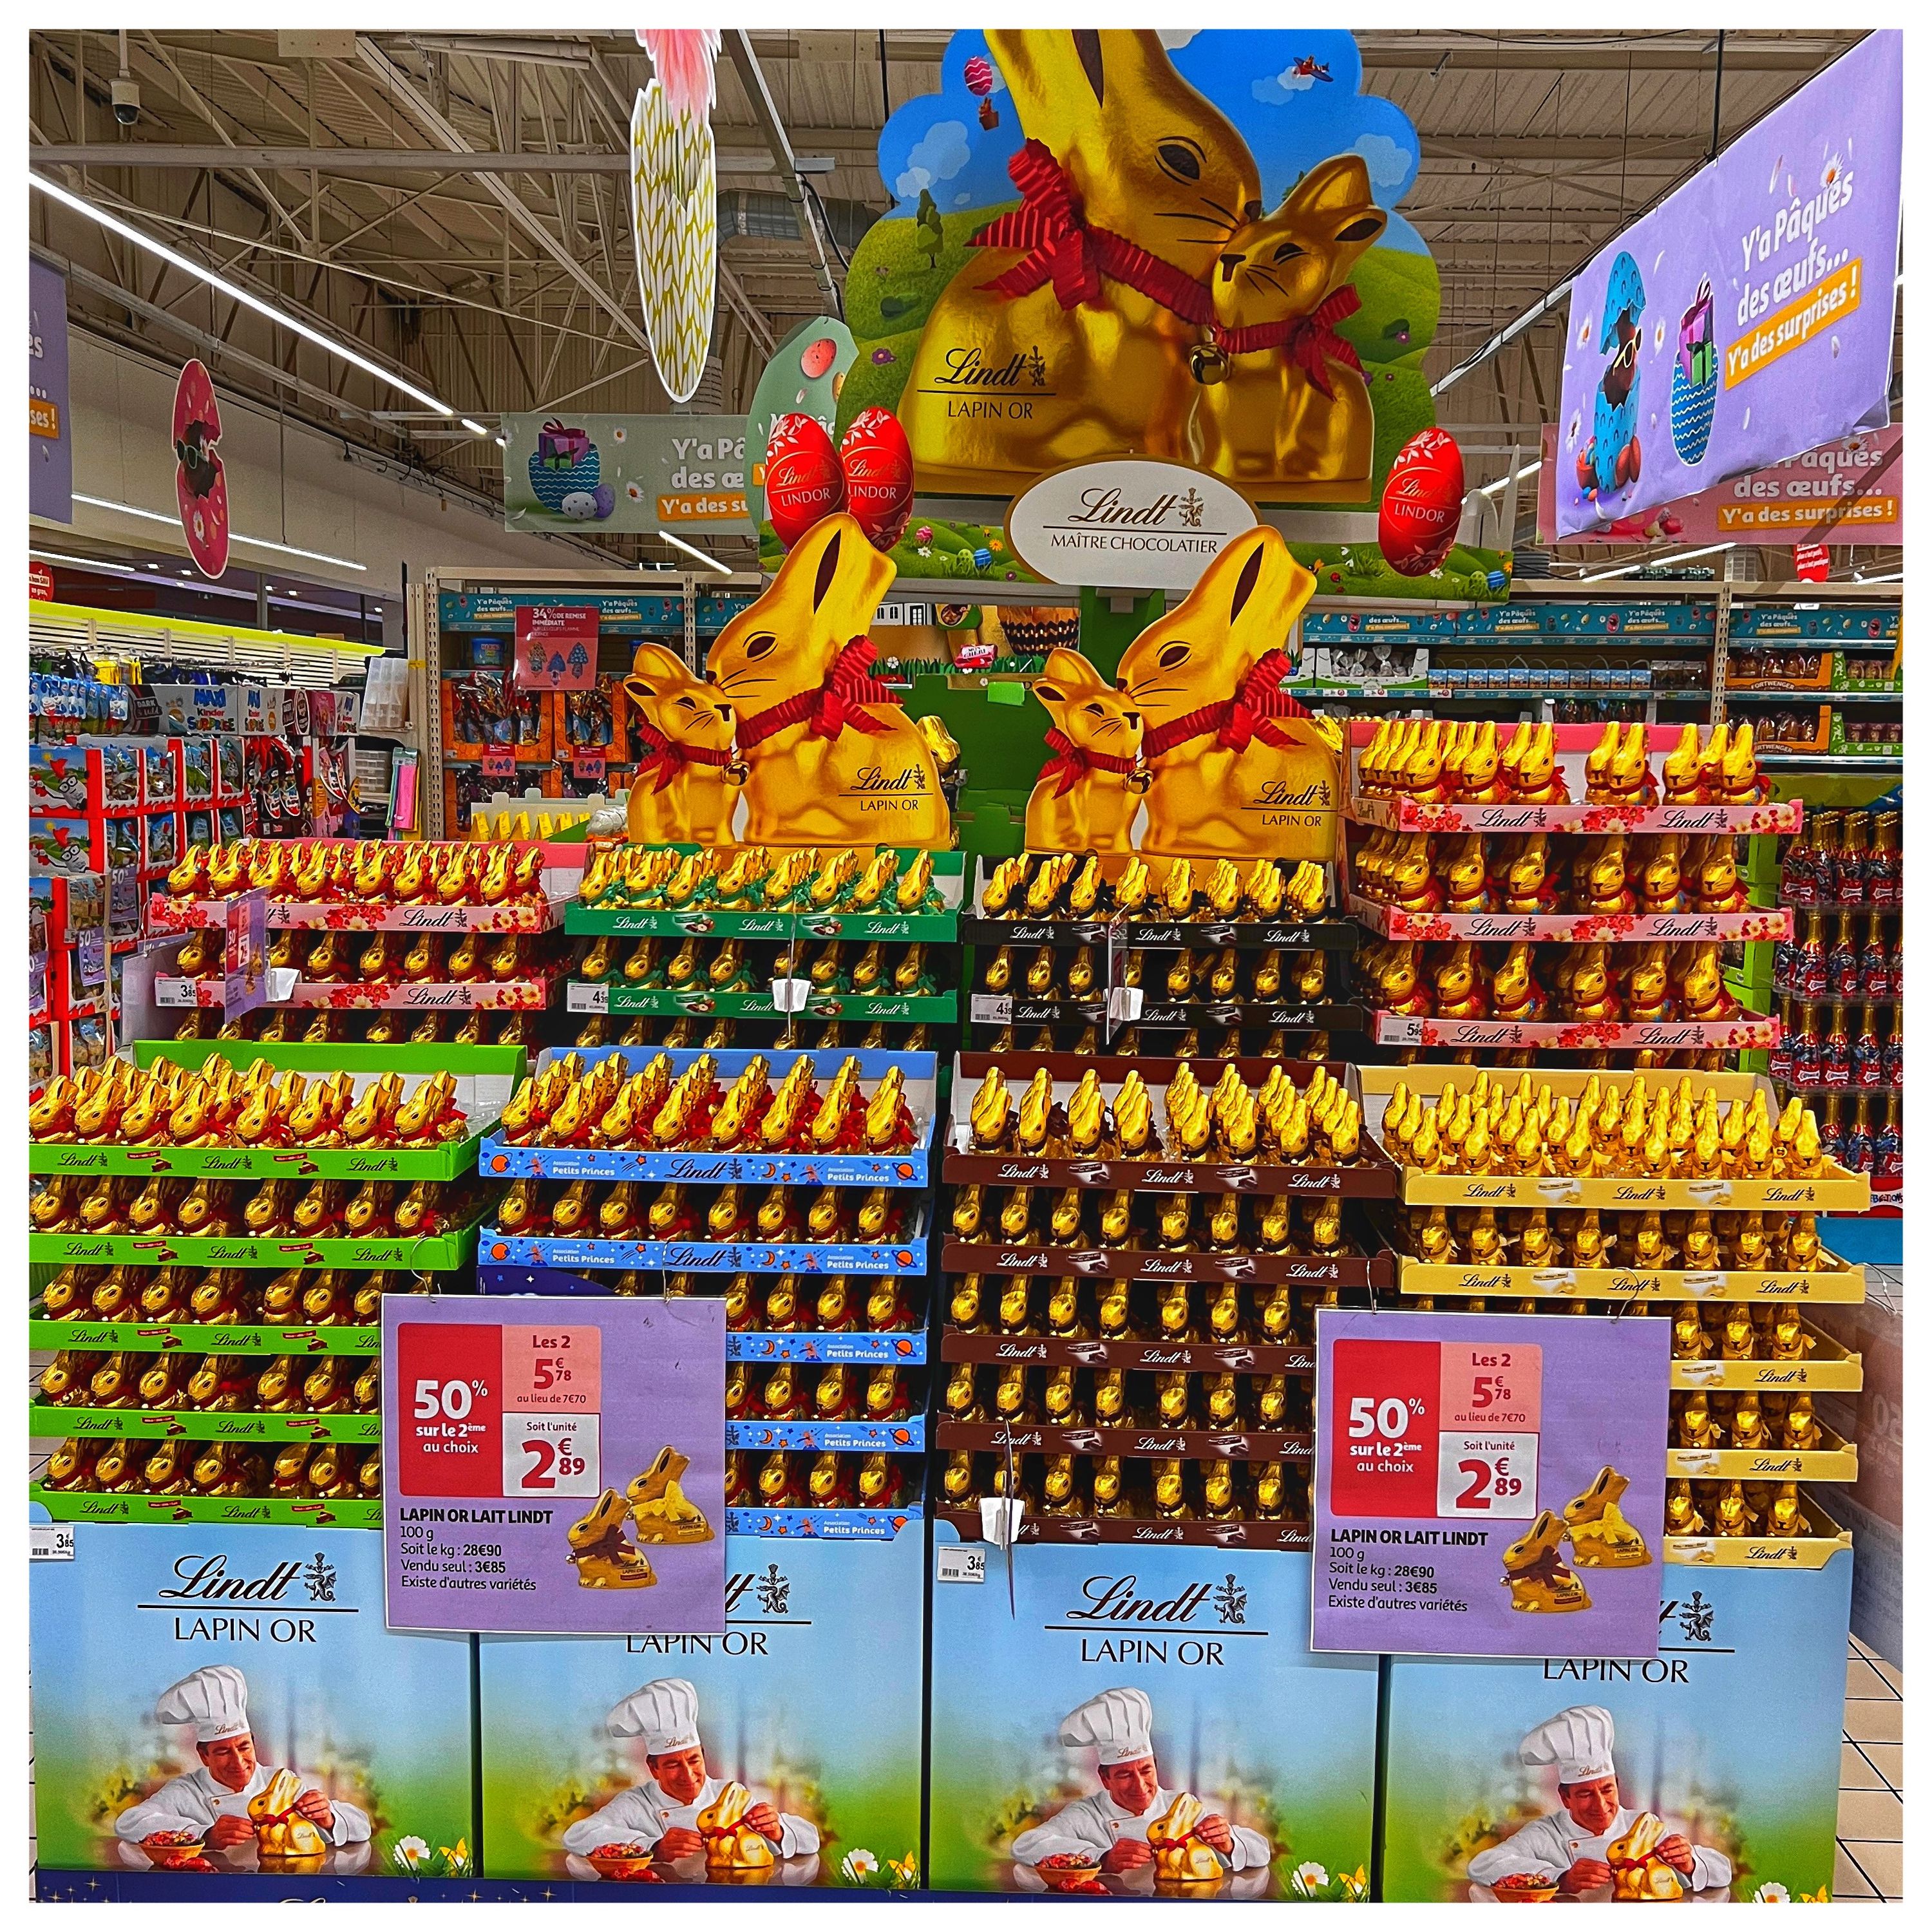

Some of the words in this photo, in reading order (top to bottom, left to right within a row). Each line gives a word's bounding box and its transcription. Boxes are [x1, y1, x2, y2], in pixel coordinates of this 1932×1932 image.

[1742, 225, 1772, 272] Y'a
[1738, 283, 1769, 327] des
[1727, 346, 1750, 377] Y'a
[1752, 330, 1776, 362] des
[1776, 281, 1847, 346] surprises
[1851, 265, 1857, 298] !
[934, 348, 1027, 386] Lindt
[947, 400, 1003, 419] LAPIN
[1009, 400, 1034, 419] OR
[671, 438, 712, 460] Y'a
[776, 464, 817, 488] Lindt
[848, 459, 890, 477] Lindt
[672, 467, 715, 488] des
[1734, 475, 1779, 497] des
[781, 488, 831, 507] LINDOR
[661, 499, 692, 515] Y'a
[696, 498, 728, 513] des
[1068, 488, 1178, 526] Lindt
[1394, 503, 1444, 523] LINDOR
[1723, 508, 1754, 524] Y'a
[1758, 507, 1790, 522] des
[1795, 502, 1882, 524] surprises
[1887, 500, 1893, 516] !
[1051, 531, 1107, 551] MAÎTRE
[1110, 536, 1217, 553] CHOCOLATIER
[1751, 681, 1795, 690] FORTWENGER
[851, 768, 911, 791] Lindt
[1253, 782, 1317, 806] Lindt
[860, 799, 898, 811] LAPIN
[901, 798, 919, 811] OR
[1262, 814, 1301, 827] LAPIN
[1305, 815, 1321, 827] OR
[1475, 808, 1532, 829] Lindt
[1657, 810, 1716, 829] Lindt
[399, 909, 453, 929] Lindt
[612, 916, 647, 931] Lindt
[739, 918, 774, 933] Lindt
[865, 921, 900, 934] Lindt
[1009, 925, 1045, 941] Lindt
[1135, 928, 1171, 943] Lindt
[1464, 917, 1522, 939] Lindt
[1263, 929, 1300, 943] Lindt
[403, 987, 457, 1006] Lindt
[1450, 1025, 1508, 1046] Lindt
[57, 1153, 96, 1168] Lindt
[202, 1155, 240, 1170] Lindt
[350, 1157, 388, 1173] Lindt
[553, 1166, 579, 1175] Petits
[582, 1167, 615, 1177] Princes
[664, 1159, 726, 1180] Lindt
[998, 1164, 1036, 1179] Lindt
[1142, 1169, 1181, 1184] Lindt
[828, 1173, 855, 1182] Petits
[857, 1173, 889, 1183] Princes
[1288, 1173, 1328, 1188] Lindt
[1463, 1184, 1506, 1198] Lindt
[1613, 1186, 1655, 1200] Lindt
[1762, 1187, 1805, 1202] Lindt
[533, 1335, 557, 1349] Les
[561, 1335, 571, 1349] 2
[1472, 1352, 1497, 1367] Les
[1501, 1353, 1511, 1367] 2
[414, 1379, 488, 1419] 50%
[531, 1394, 548, 1403] lieu
[550, 1394, 561, 1403] de
[563, 1394, 586, 1403] 7€70
[1349, 1397, 1425, 1438] 50%
[1468, 1413, 1486, 1422] lieu
[1488, 1413, 1501, 1422] de
[1502, 1414, 1526, 1423] 7€70
[416, 1426, 439, 1437] sur
[442, 1423, 455, 1437] le
[458, 1423, 486, 1437] 2ème
[527, 1422, 545, 1432] Soit
[547, 1422, 577, 1432] l'unité
[423, 1443, 440, 1453] au
[443, 1441, 478, 1453] choix
[1350, 1444, 1374, 1456] sur
[1376, 1442, 1391, 1457] le
[1394, 1441, 1422, 1457] 2ème
[1464, 1441, 1483, 1450] Soit
[1484, 1441, 1515, 1450] l'unité
[1357, 1463, 1374, 1472] au
[1377, 1460, 1414, 1473] choix
[399, 1508, 444, 1522] LAPIN
[447, 1509, 469, 1522] OR
[471, 1509, 506, 1524] LAIT
[508, 1510, 553, 1524] LINDT
[400, 1526, 423, 1538] 100
[426, 1528, 433, 1542] g
[1331, 1529, 1378, 1544] LAPIN
[1379, 1530, 1403, 1544] OR
[1405, 1531, 1440, 1544] LAIT
[1442, 1531, 1488, 1546] LINDT
[401, 1542, 424, 1556] Soit
[426, 1543, 437, 1556] le
[440, 1544, 455, 1558] kg
[463, 1544, 502, 1557] 28€90
[1329, 1547, 1354, 1558] 100
[1356, 1549, 1365, 1562] g
[401, 1559, 440, 1572] Vendu
[442, 1560, 466, 1573] seul
[475, 1561, 506, 1573] 3€85
[1329, 1562, 1353, 1575] Soit
[1356, 1563, 1368, 1575] le
[1370, 1564, 1385, 1578] kg
[1394, 1566, 1434, 1578] 28€90
[158, 1555, 301, 1602] Lindt
[401, 1575, 437, 1589] Existe
[439, 1575, 487, 1589] d'autres
[489, 1577, 536, 1591] variétés
[1329, 1578, 1368, 1591] Vendu
[1370, 1580, 1396, 1592] seul
[1405, 1580, 1437, 1594] 3€85
[1066, 1575, 1213, 1622] Lindt
[1329, 1595, 1365, 1608] Existe
[1367, 1596, 1417, 1610] d'autres
[1419, 1597, 1468, 1611] variétés
[175, 1618, 260, 1642] LAPIN
[270, 1618, 317, 1642] OR
[627, 1634, 712, 1654] LAPIN
[722, 1631, 768, 1656] OR
[1081, 1639, 1166, 1663] LAPIN
[1178, 1642, 1224, 1665] OR
[1544, 1660, 1631, 1682] LAPIN
[1642, 1659, 1689, 1683] OR
